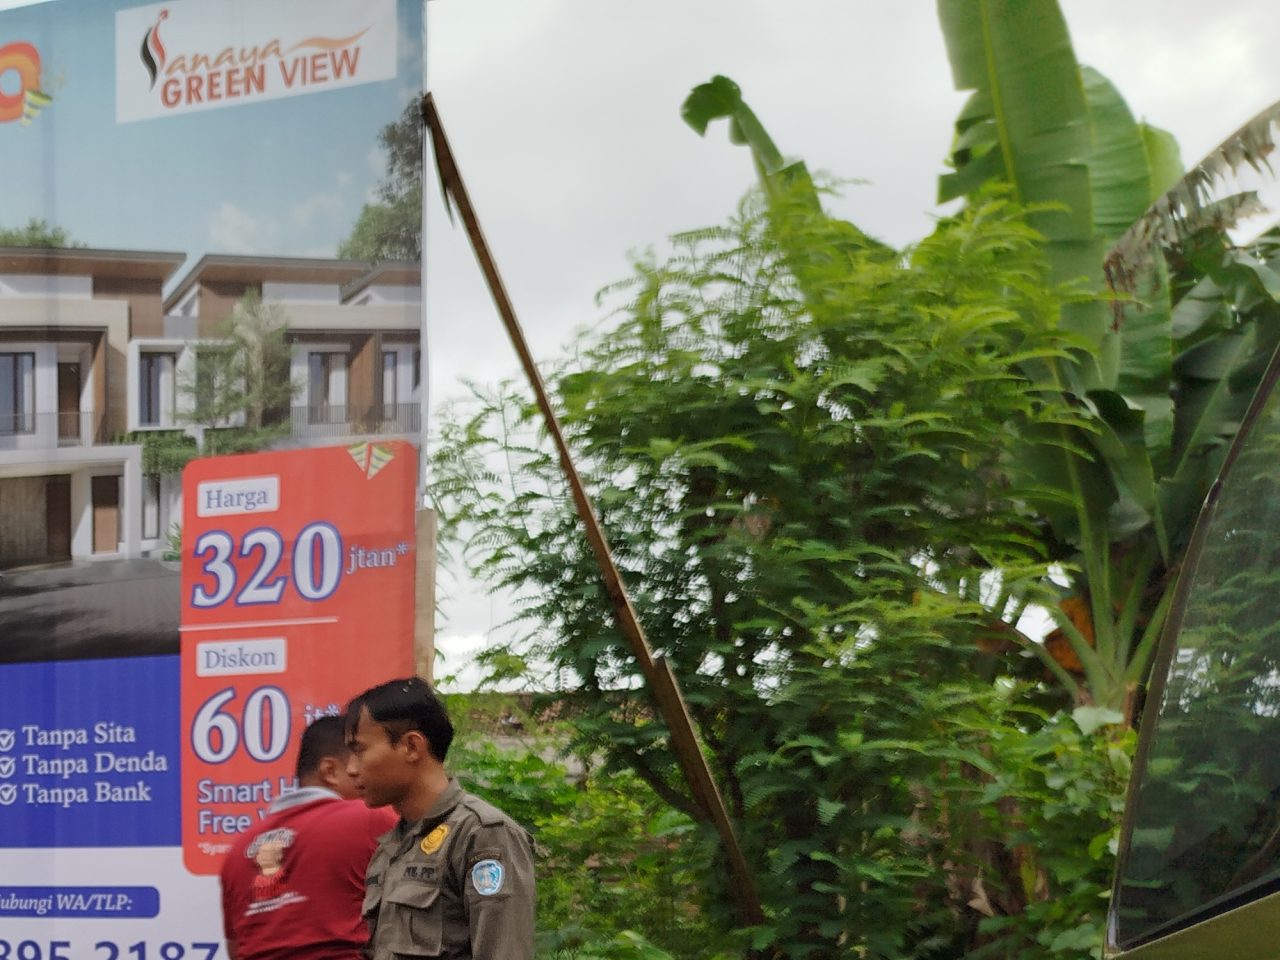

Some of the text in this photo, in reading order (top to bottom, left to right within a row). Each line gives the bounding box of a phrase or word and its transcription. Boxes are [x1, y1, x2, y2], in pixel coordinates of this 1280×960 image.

[160, 47, 361, 108] GREEN VIEW
[204, 487, 269, 512] Harga
[190, 520, 344, 610] 320
[204, 645, 277, 669] Diskon
[22, 722, 136, 748] Tanpa Sita
[191, 685, 291, 764] 60
[22, 751, 168, 777] Tanpa Denda
[22, 781, 152, 805] Tanpa Bank
[198, 778, 272, 803] Smart
[198, 810, 251, 834] Free
